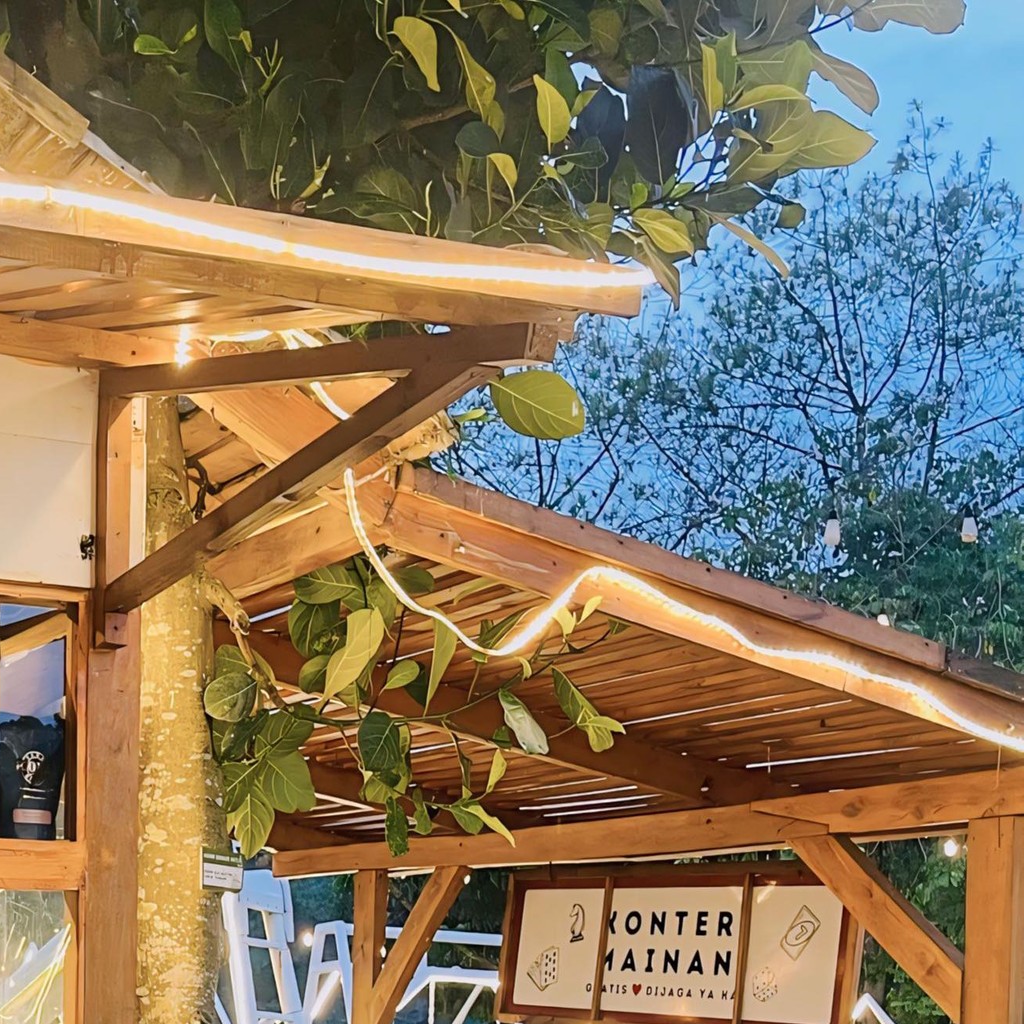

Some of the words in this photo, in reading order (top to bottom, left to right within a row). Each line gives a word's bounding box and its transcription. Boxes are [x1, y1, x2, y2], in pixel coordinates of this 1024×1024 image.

[585, 983, 628, 995] GATIS
[645, 985, 693, 998] DIJAGA
[699, 988, 714, 1000] YA
